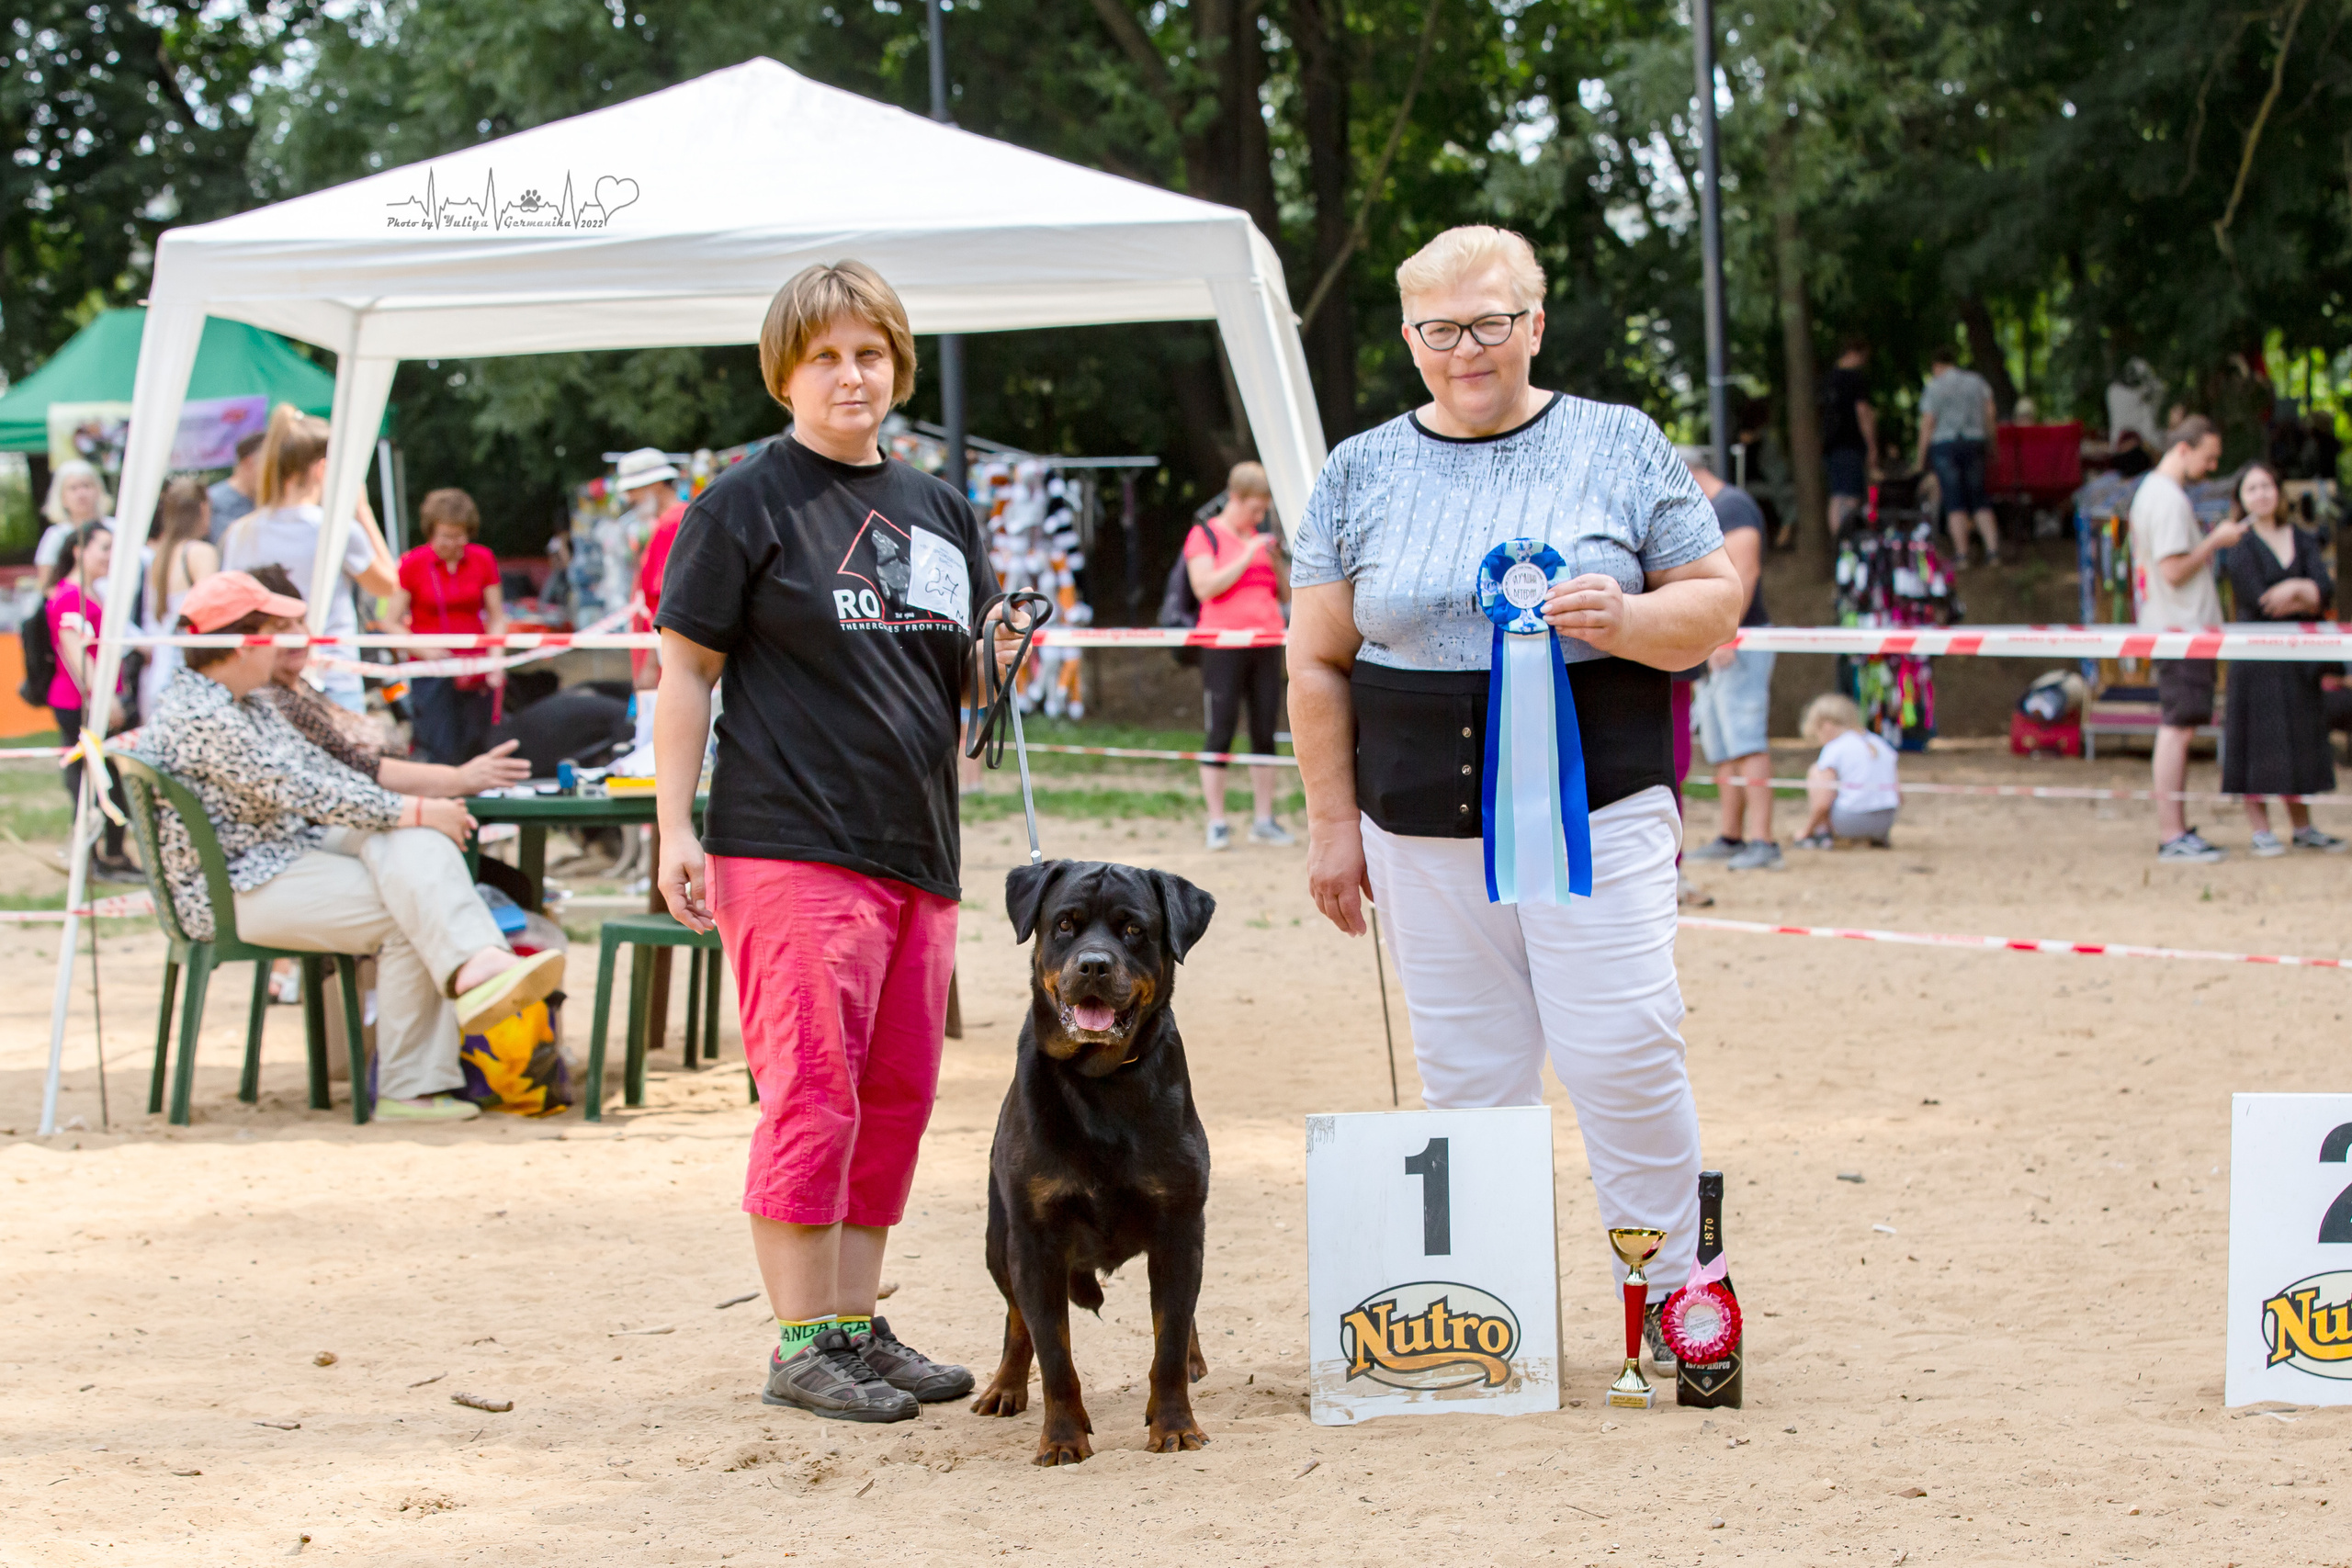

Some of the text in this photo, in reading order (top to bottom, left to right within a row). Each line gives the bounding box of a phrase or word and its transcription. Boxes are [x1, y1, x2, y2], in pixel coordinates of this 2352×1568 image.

[840, 622, 858, 631] THE
[905, 623, 933, 632] FROM
[935, 623, 954, 632] THE
[1405, 1137, 1451, 1256] 1
[1704, 1218, 1713, 1246] 1870
[1342, 1297, 1511, 1378] Nutro
